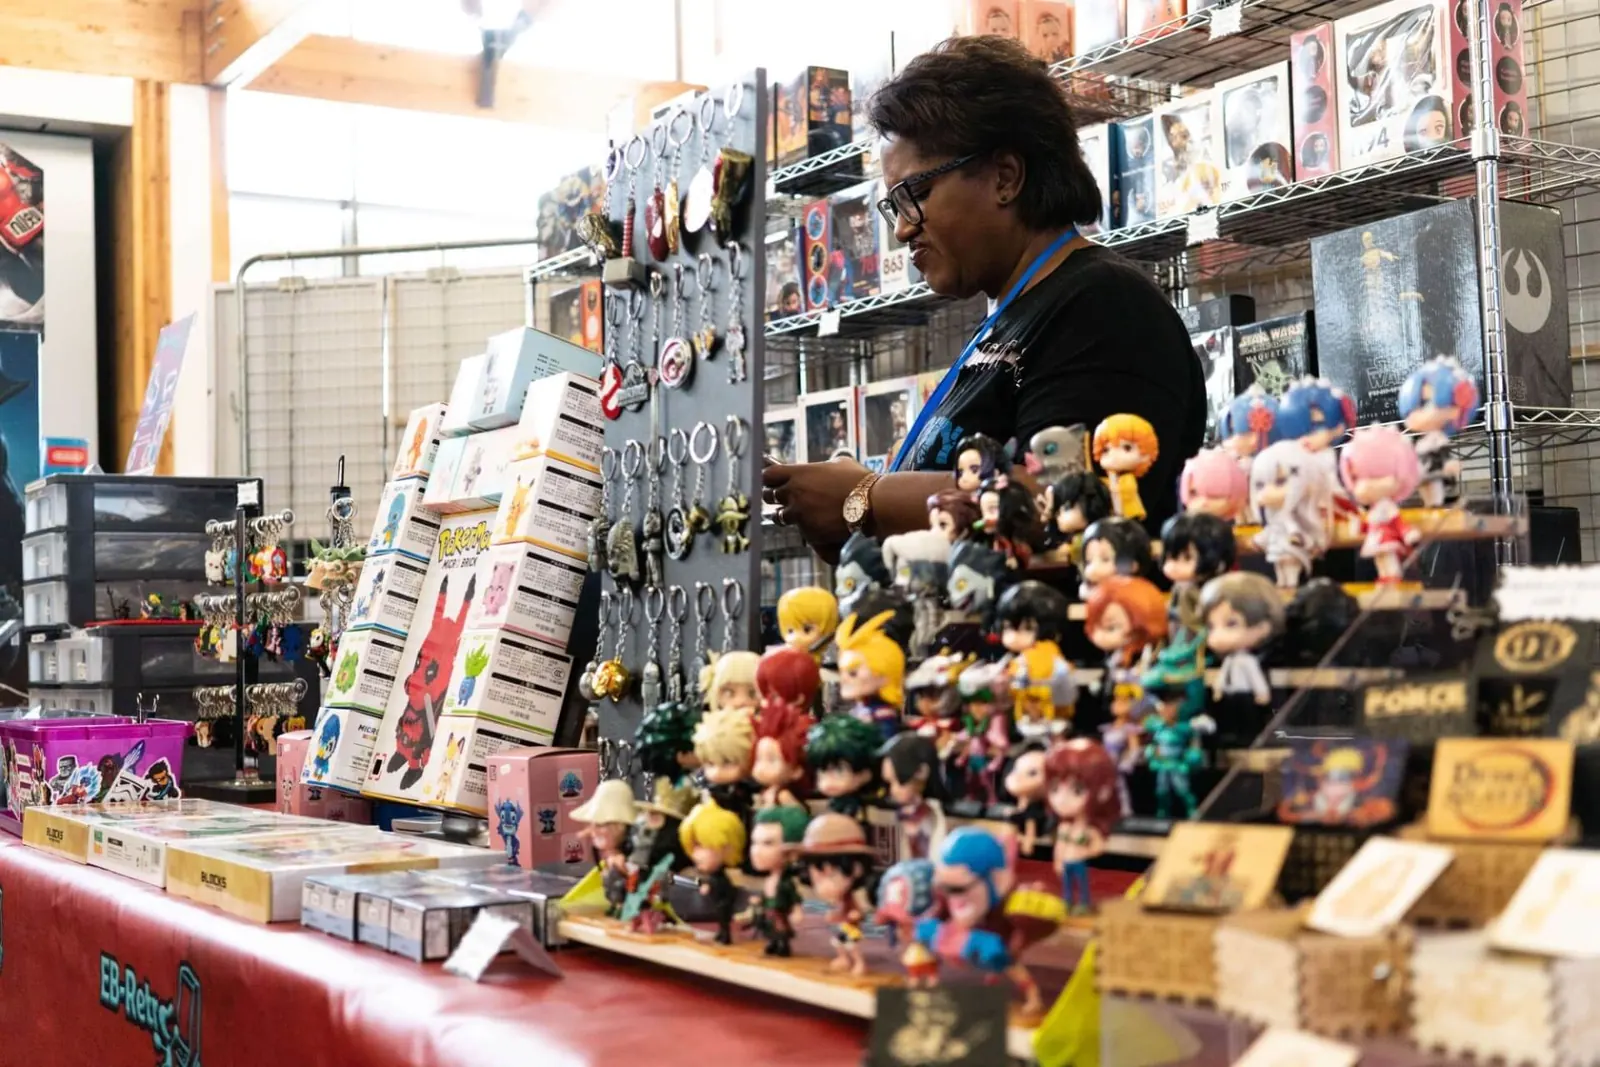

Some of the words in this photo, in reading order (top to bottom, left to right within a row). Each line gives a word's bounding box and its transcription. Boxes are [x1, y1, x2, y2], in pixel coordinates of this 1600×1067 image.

[883, 254, 904, 275] 863
[46, 826, 64, 841] BLOCKS
[200, 870, 227, 889] BLOCKS
